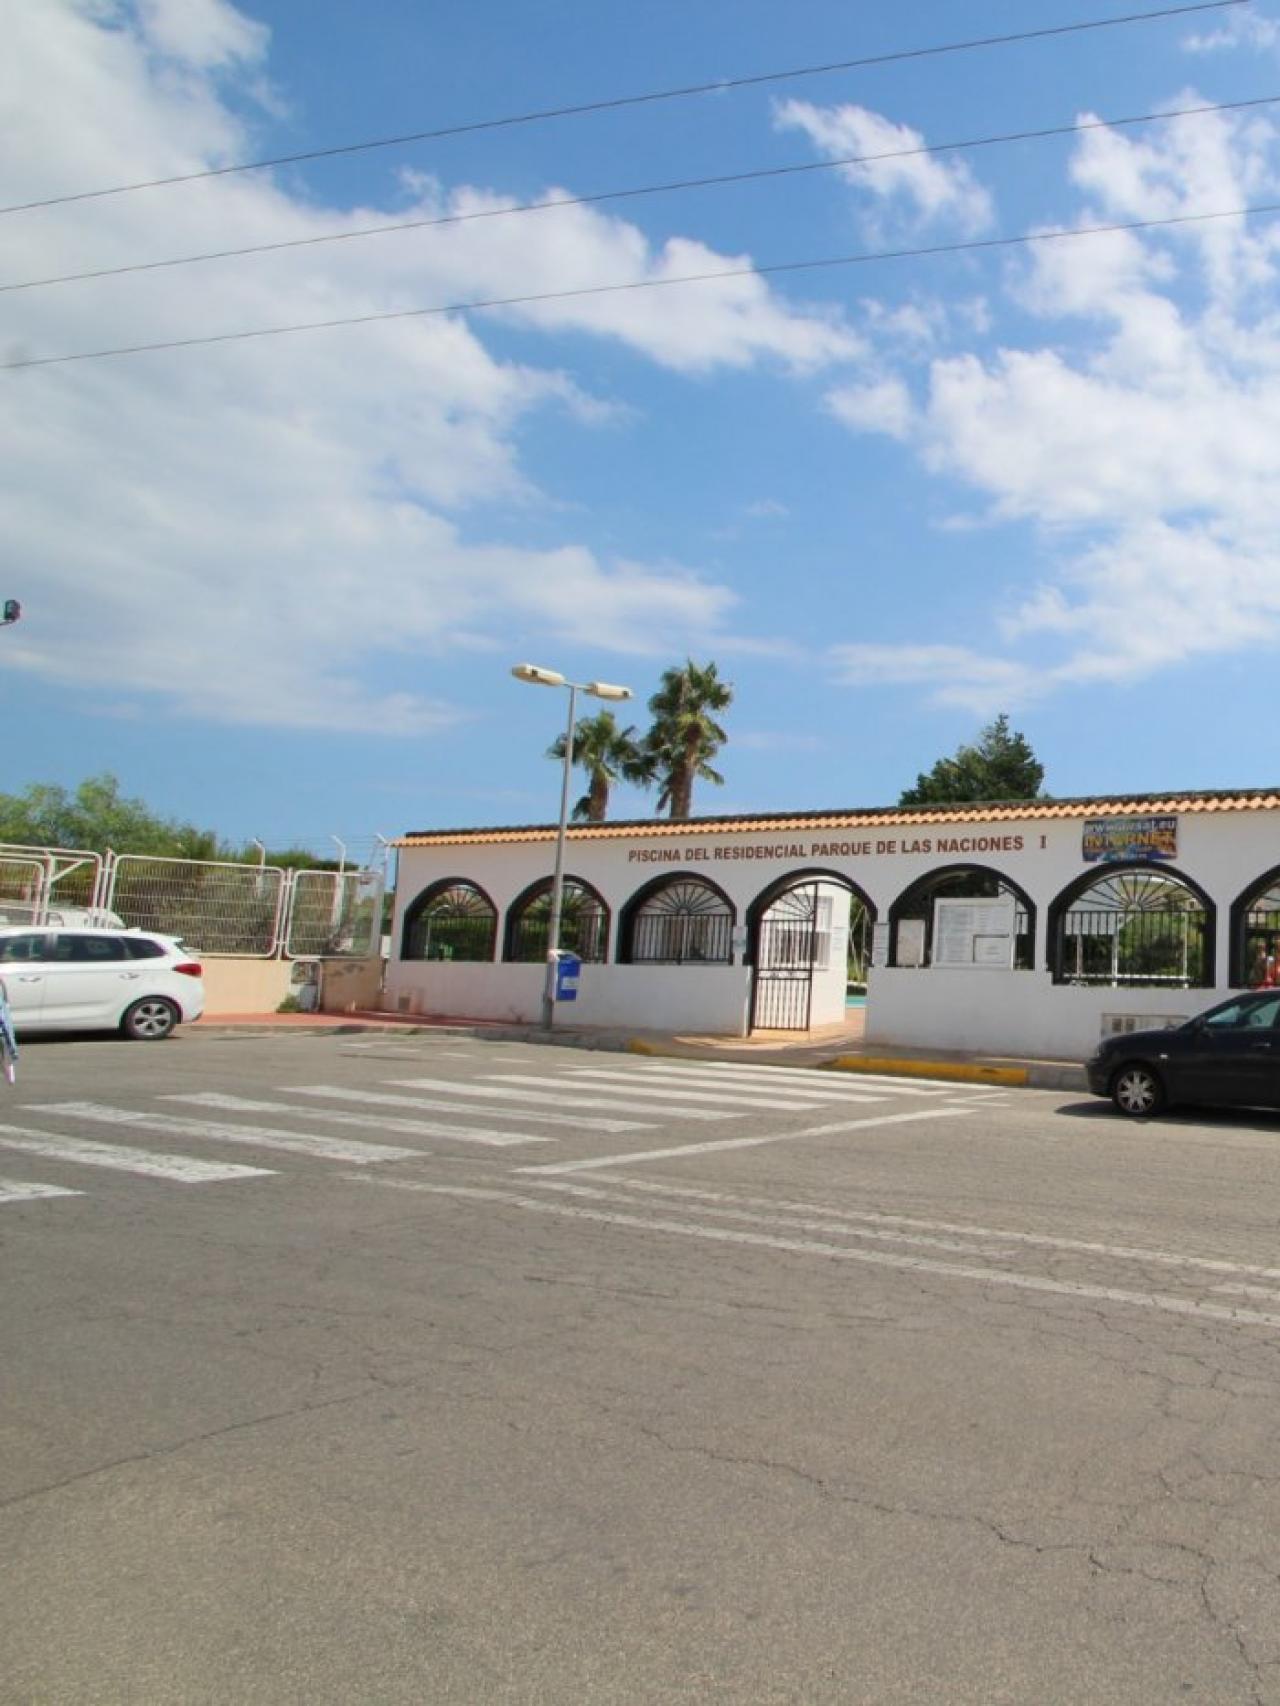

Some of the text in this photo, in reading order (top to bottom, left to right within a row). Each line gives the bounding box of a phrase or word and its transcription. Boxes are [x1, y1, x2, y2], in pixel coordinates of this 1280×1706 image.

[628, 848, 681, 862] PISCINA
[685, 847, 710, 861] DEL
[714, 844, 807, 860] RESIDENCIAL
[811, 841, 871, 857] PARQUE
[876, 840, 897, 855] DE
[901, 839, 932, 854] LAS
[937, 835, 1024, 852] NACIONES
